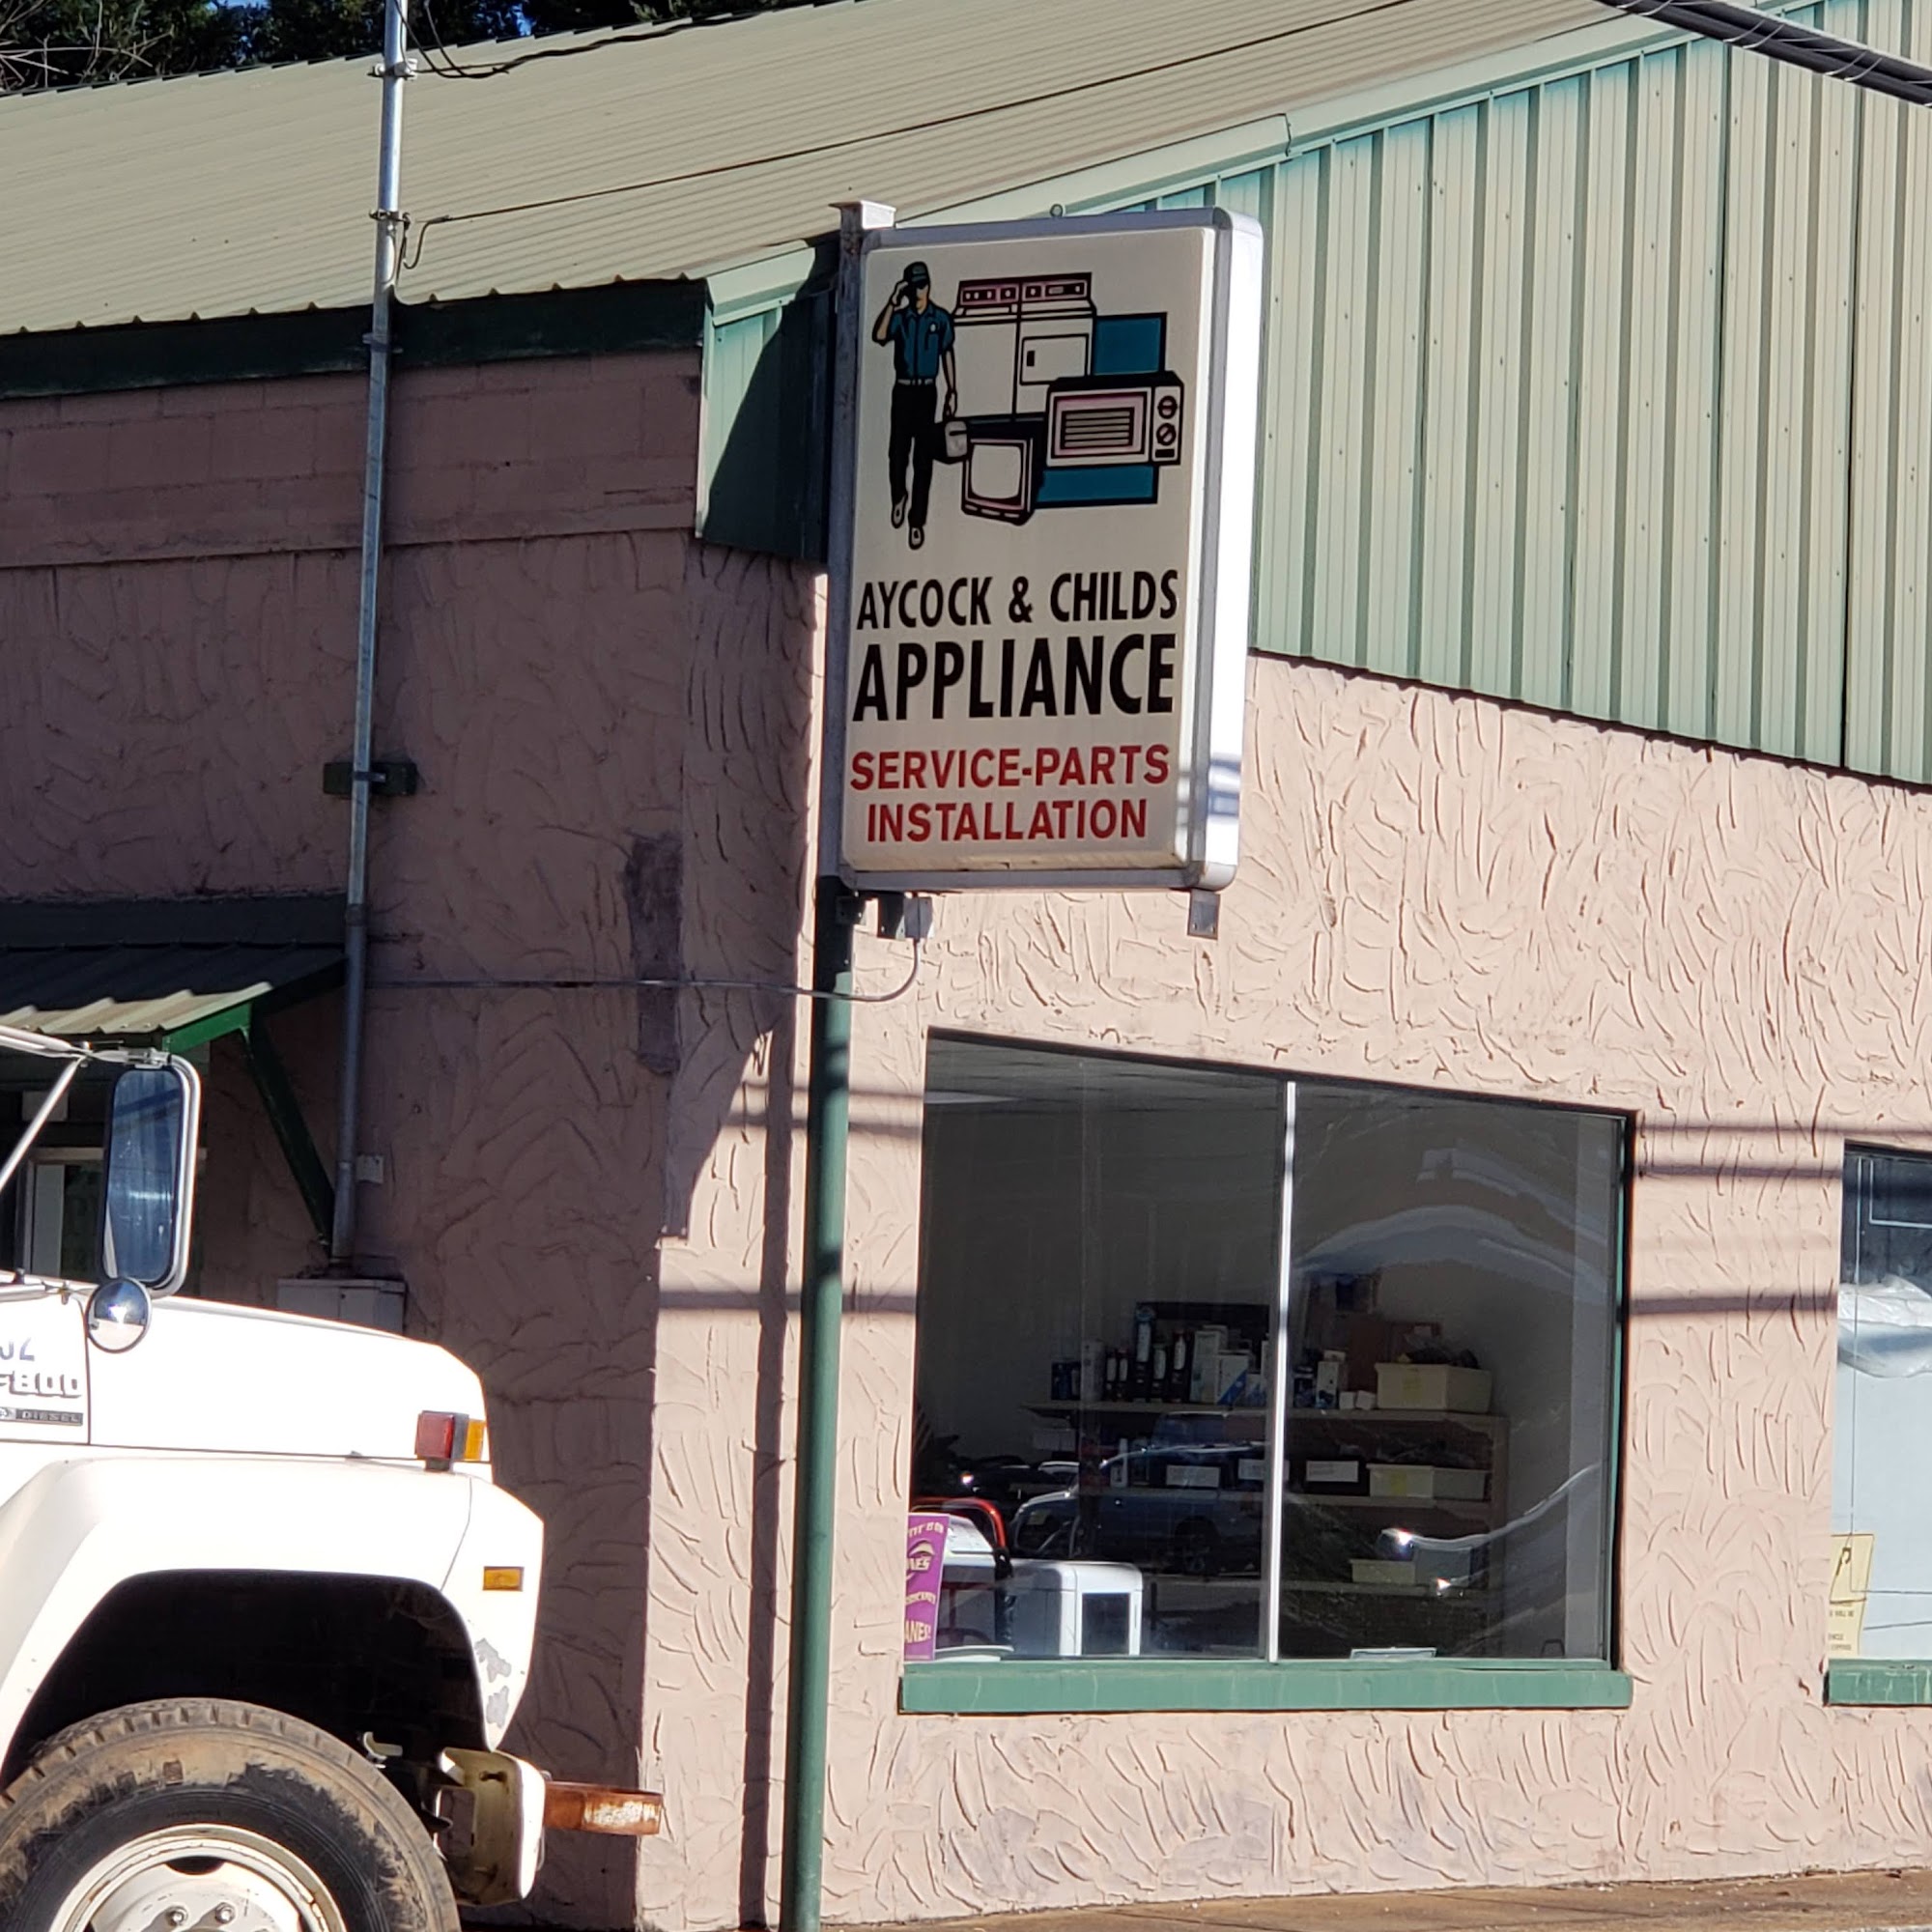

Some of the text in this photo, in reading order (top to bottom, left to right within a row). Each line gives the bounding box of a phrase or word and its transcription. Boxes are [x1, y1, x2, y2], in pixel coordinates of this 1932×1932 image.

[856, 569, 1179, 630] AYCOCK & CHILDS
[852, 633, 1176, 722] APPLIANCE
[850, 743, 1170, 791] SERVICE-PARTS
[867, 799, 1148, 842] INSTALLATION
